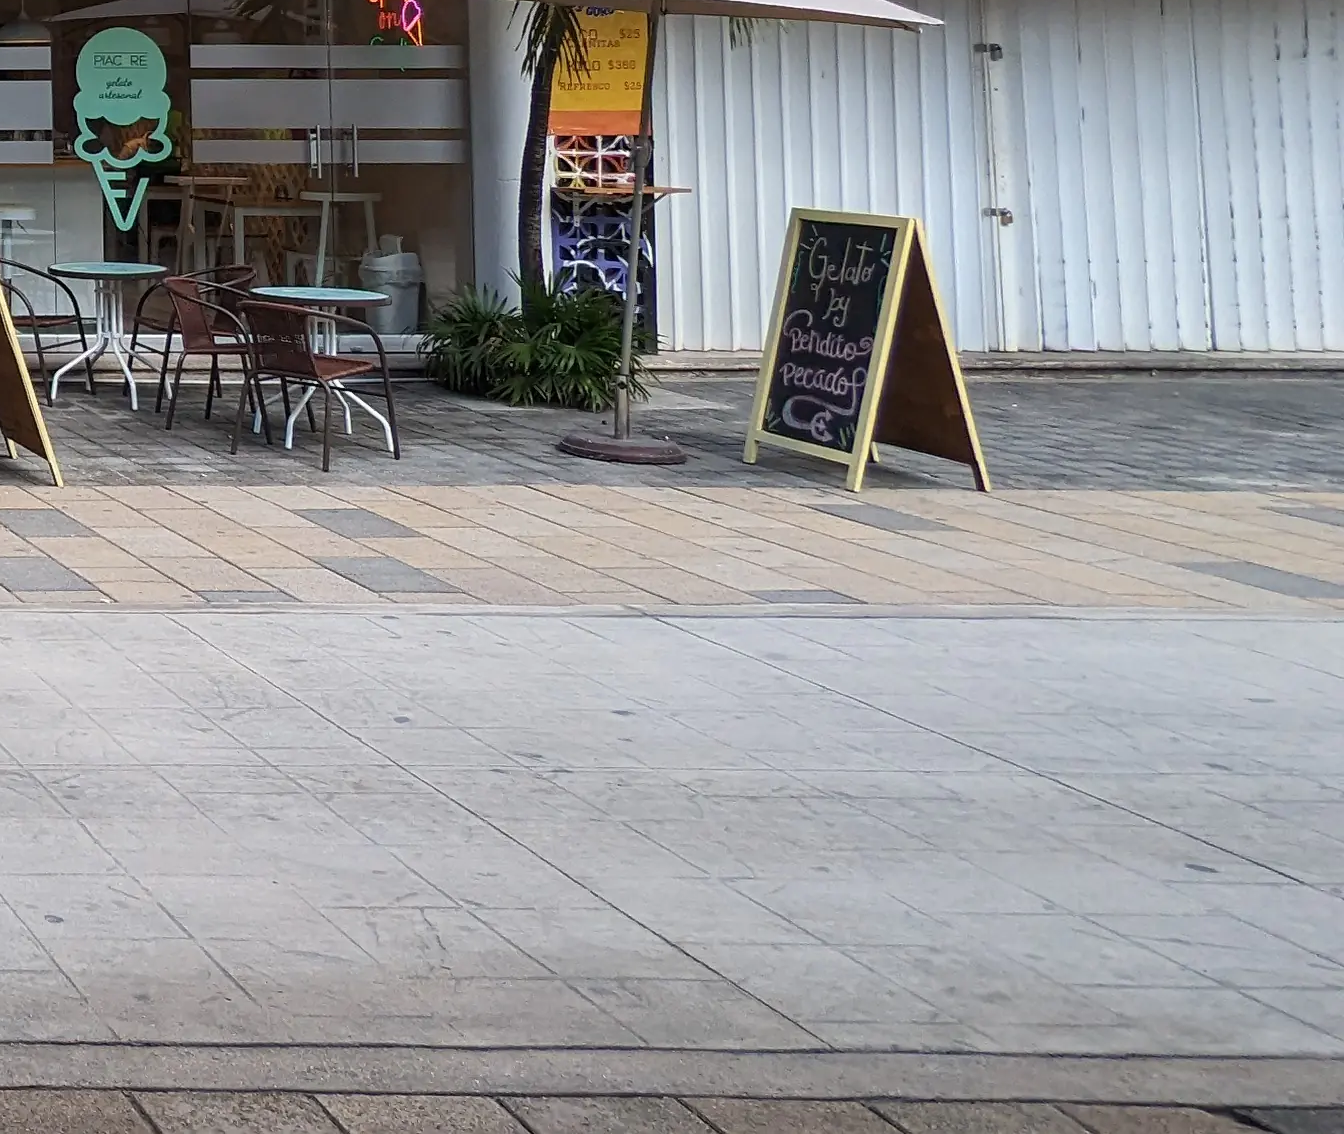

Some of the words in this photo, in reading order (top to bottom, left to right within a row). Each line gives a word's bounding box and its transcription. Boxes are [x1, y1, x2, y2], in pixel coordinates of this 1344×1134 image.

[808, 236, 876, 302] Gelato
[822, 287, 851, 328] by
[784, 310, 875, 360] Bendito
